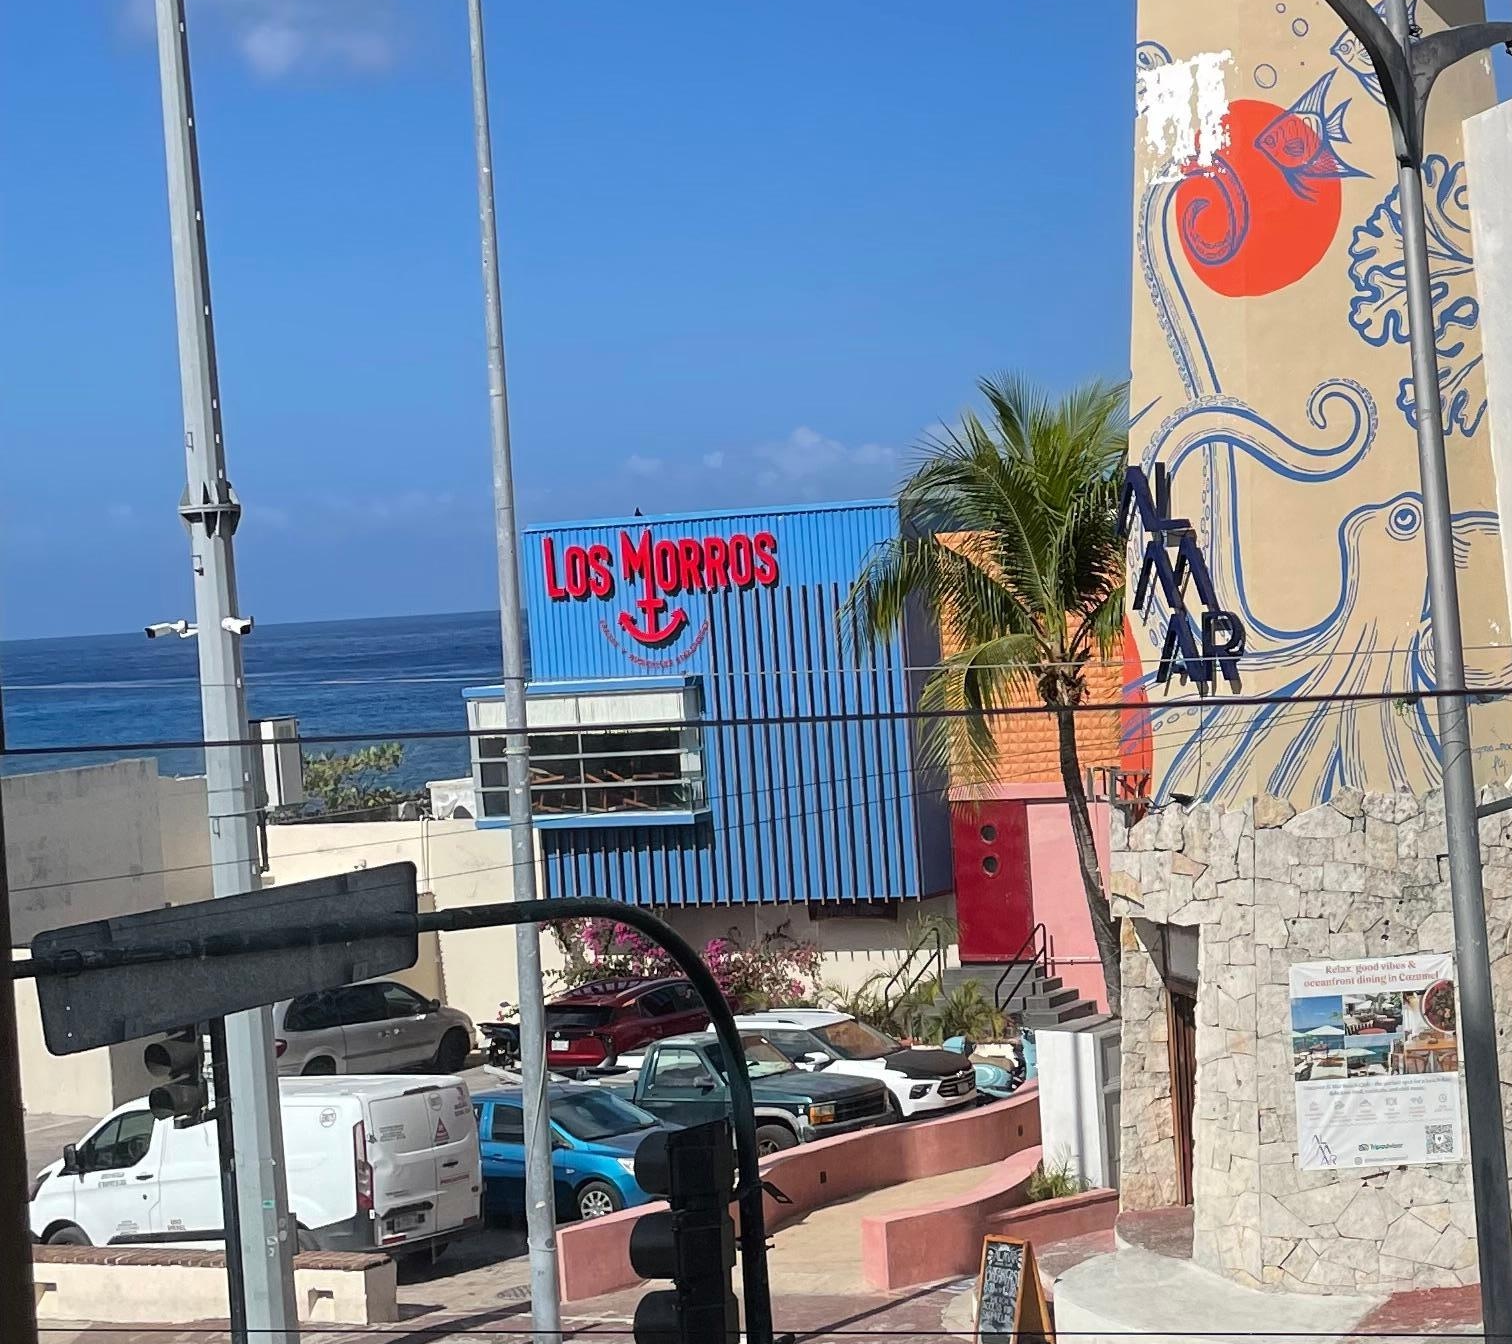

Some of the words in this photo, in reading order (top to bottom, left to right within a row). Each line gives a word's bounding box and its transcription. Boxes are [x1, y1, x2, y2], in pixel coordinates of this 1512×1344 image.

[542, 537, 613, 599] LOS
[620, 528, 778, 593] MORROS
[1355, 962, 1379, 975] good
[1380, 961, 1406, 972] vibes
[1407, 960, 1416, 969] &
[1304, 976, 1355, 988] oceanfront
[1356, 975, 1387, 986] dining
[1388, 974, 1397, 982] in
[1399, 970, 1439, 982] Cozumel
